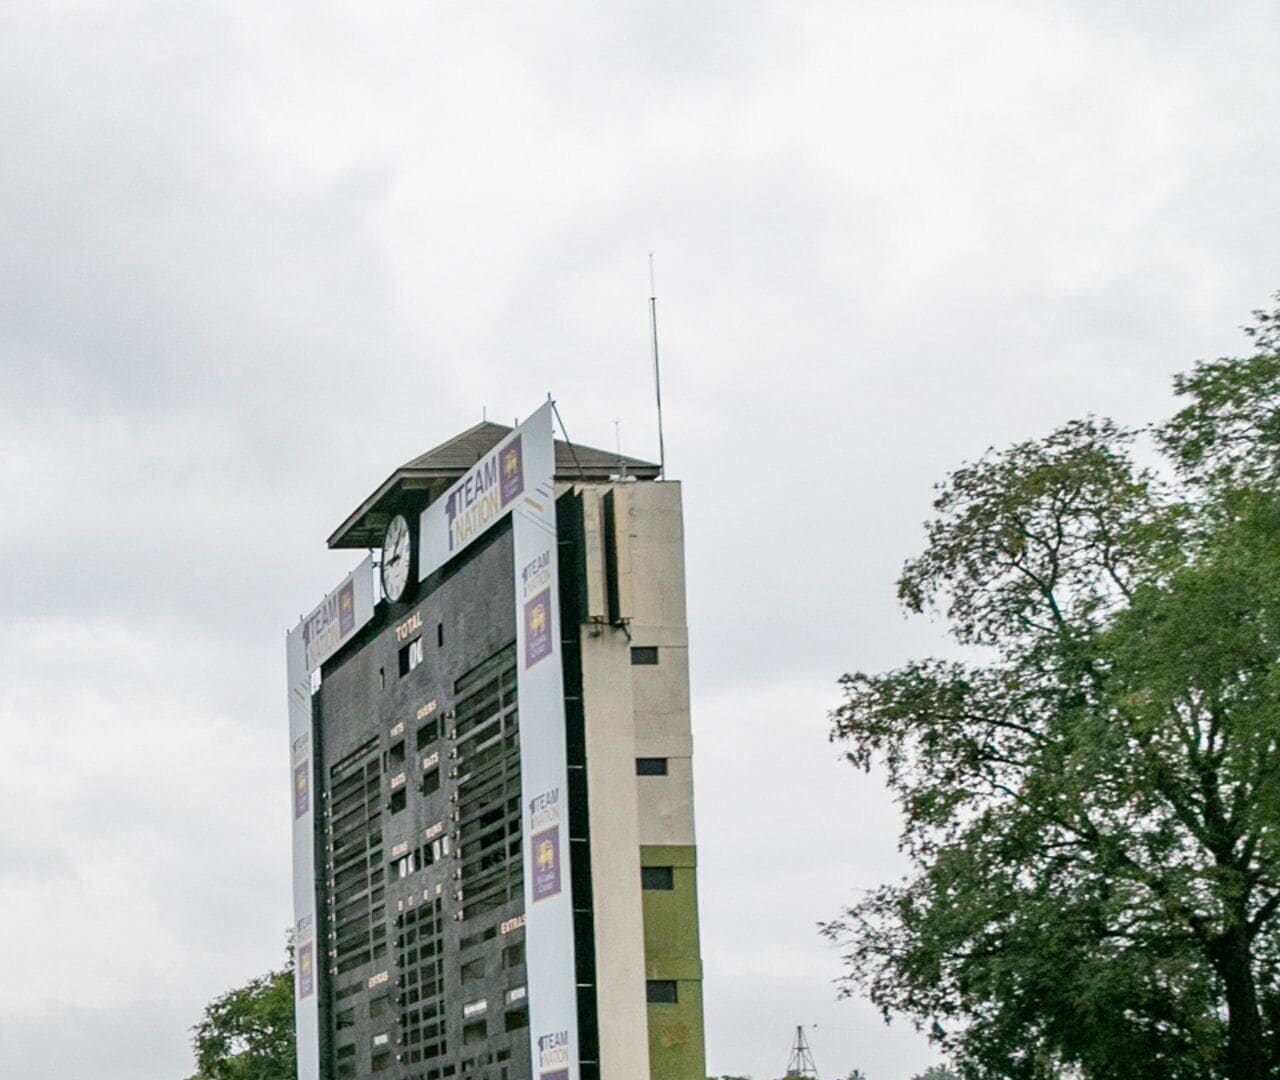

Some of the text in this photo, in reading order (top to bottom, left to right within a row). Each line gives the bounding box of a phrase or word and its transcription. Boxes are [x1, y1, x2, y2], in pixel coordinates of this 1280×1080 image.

[454, 455, 497, 513] TEAM
[456, 487, 499, 545] NATION
[395, 611, 423, 642] TOTAL
[535, 787, 559, 810] TEAM
[543, 1031, 568, 1050] TEAM
